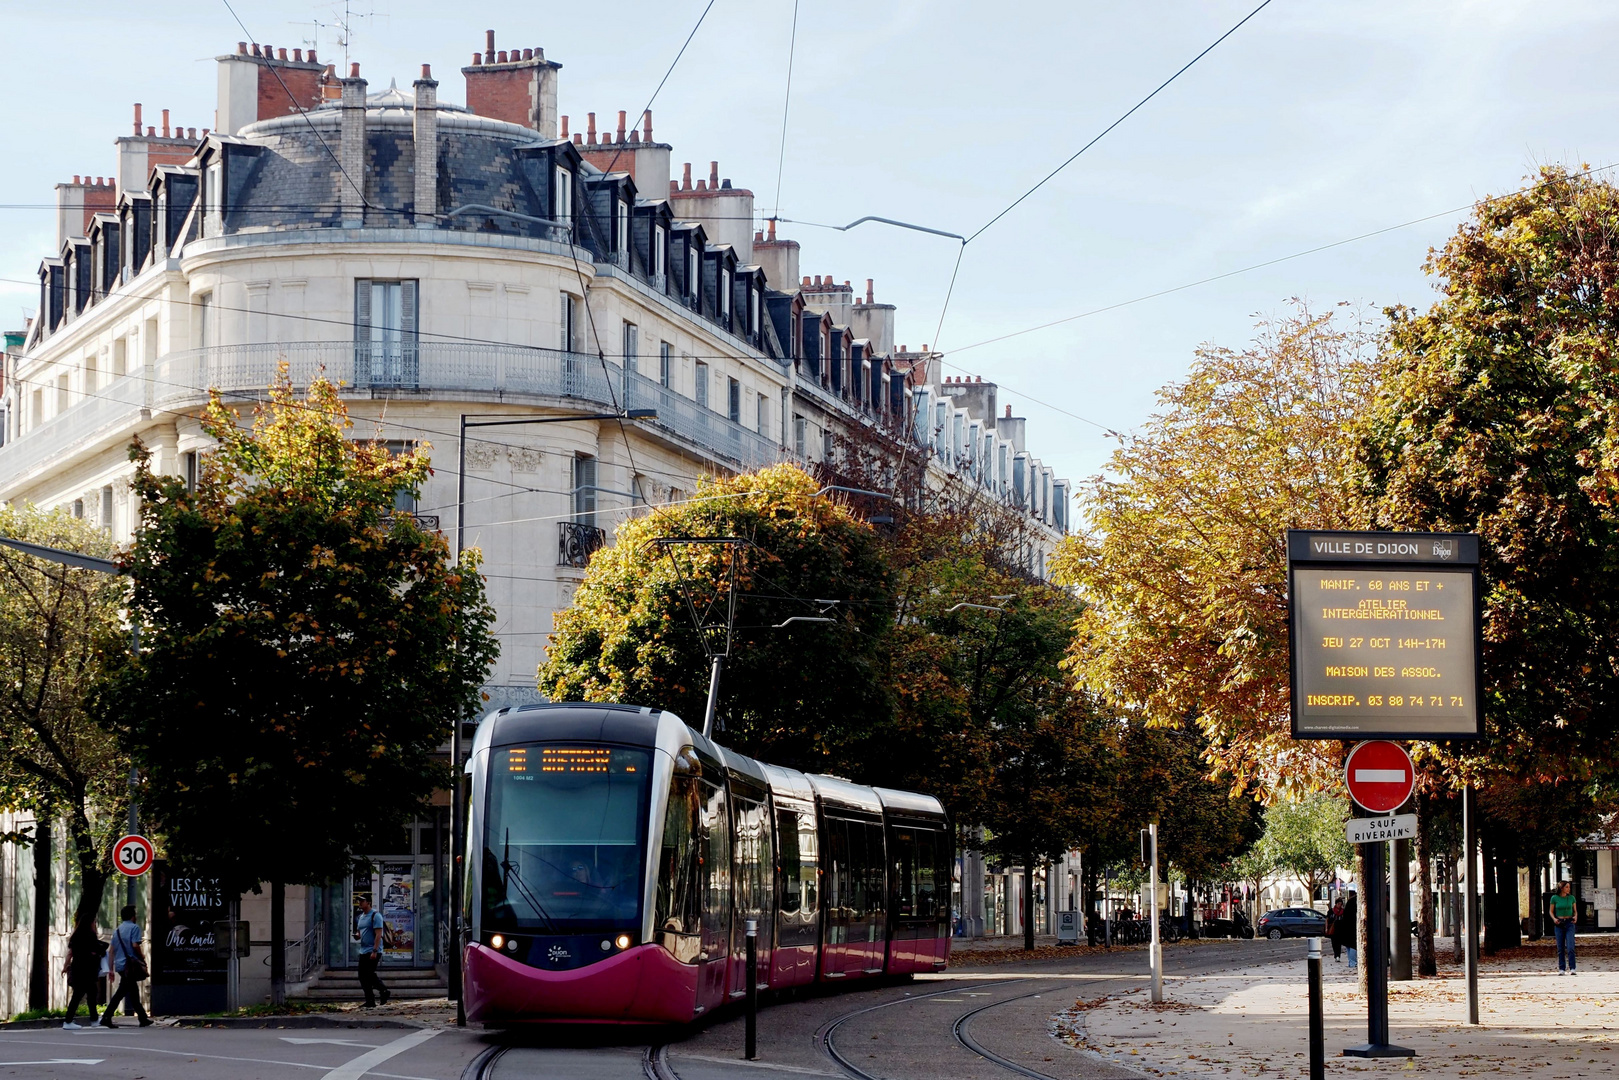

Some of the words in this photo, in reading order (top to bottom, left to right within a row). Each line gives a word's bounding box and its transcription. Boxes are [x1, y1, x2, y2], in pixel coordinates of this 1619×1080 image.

[1314, 542, 1351, 554] VILLE
[1355, 543, 1373, 554] DE
[1377, 543, 1419, 555] DIJON
[1432, 545, 1452, 558] Dijon
[1320, 579, 1360, 590] MANIF.
[1368, 580, 1383, 590] 60
[1388, 580, 1410, 591] ANS
[1416, 581, 1430, 591] ET
[1436, 582, 1444, 590] +
[1358, 599, 1407, 610] ATELIER
[1322, 608, 1445, 620] INTERGENERATIONNEL
[1322, 637, 1343, 648] JEU
[1349, 637, 1364, 648] 27
[1369, 638, 1391, 648] OCT
[1398, 638, 1446, 649] 14H-17H
[1326, 666, 1368, 677] MAISON
[1374, 667, 1396, 677] DES
[1401, 667, 1441, 678] ASSOC.
[1307, 695, 1360, 706] INSCRIP.
[1368, 695, 1383, 706] 03
[1388, 696, 1404, 706] 80
[1409, 696, 1424, 707] 74
[1429, 696, 1443, 707] 71
[1450, 696, 1464, 707] 71
[1370, 819, 1396, 829] SAUF
[121, 847, 146, 865] 30
[171, 878, 190, 892] LES
[165, 930, 186, 947] Une
